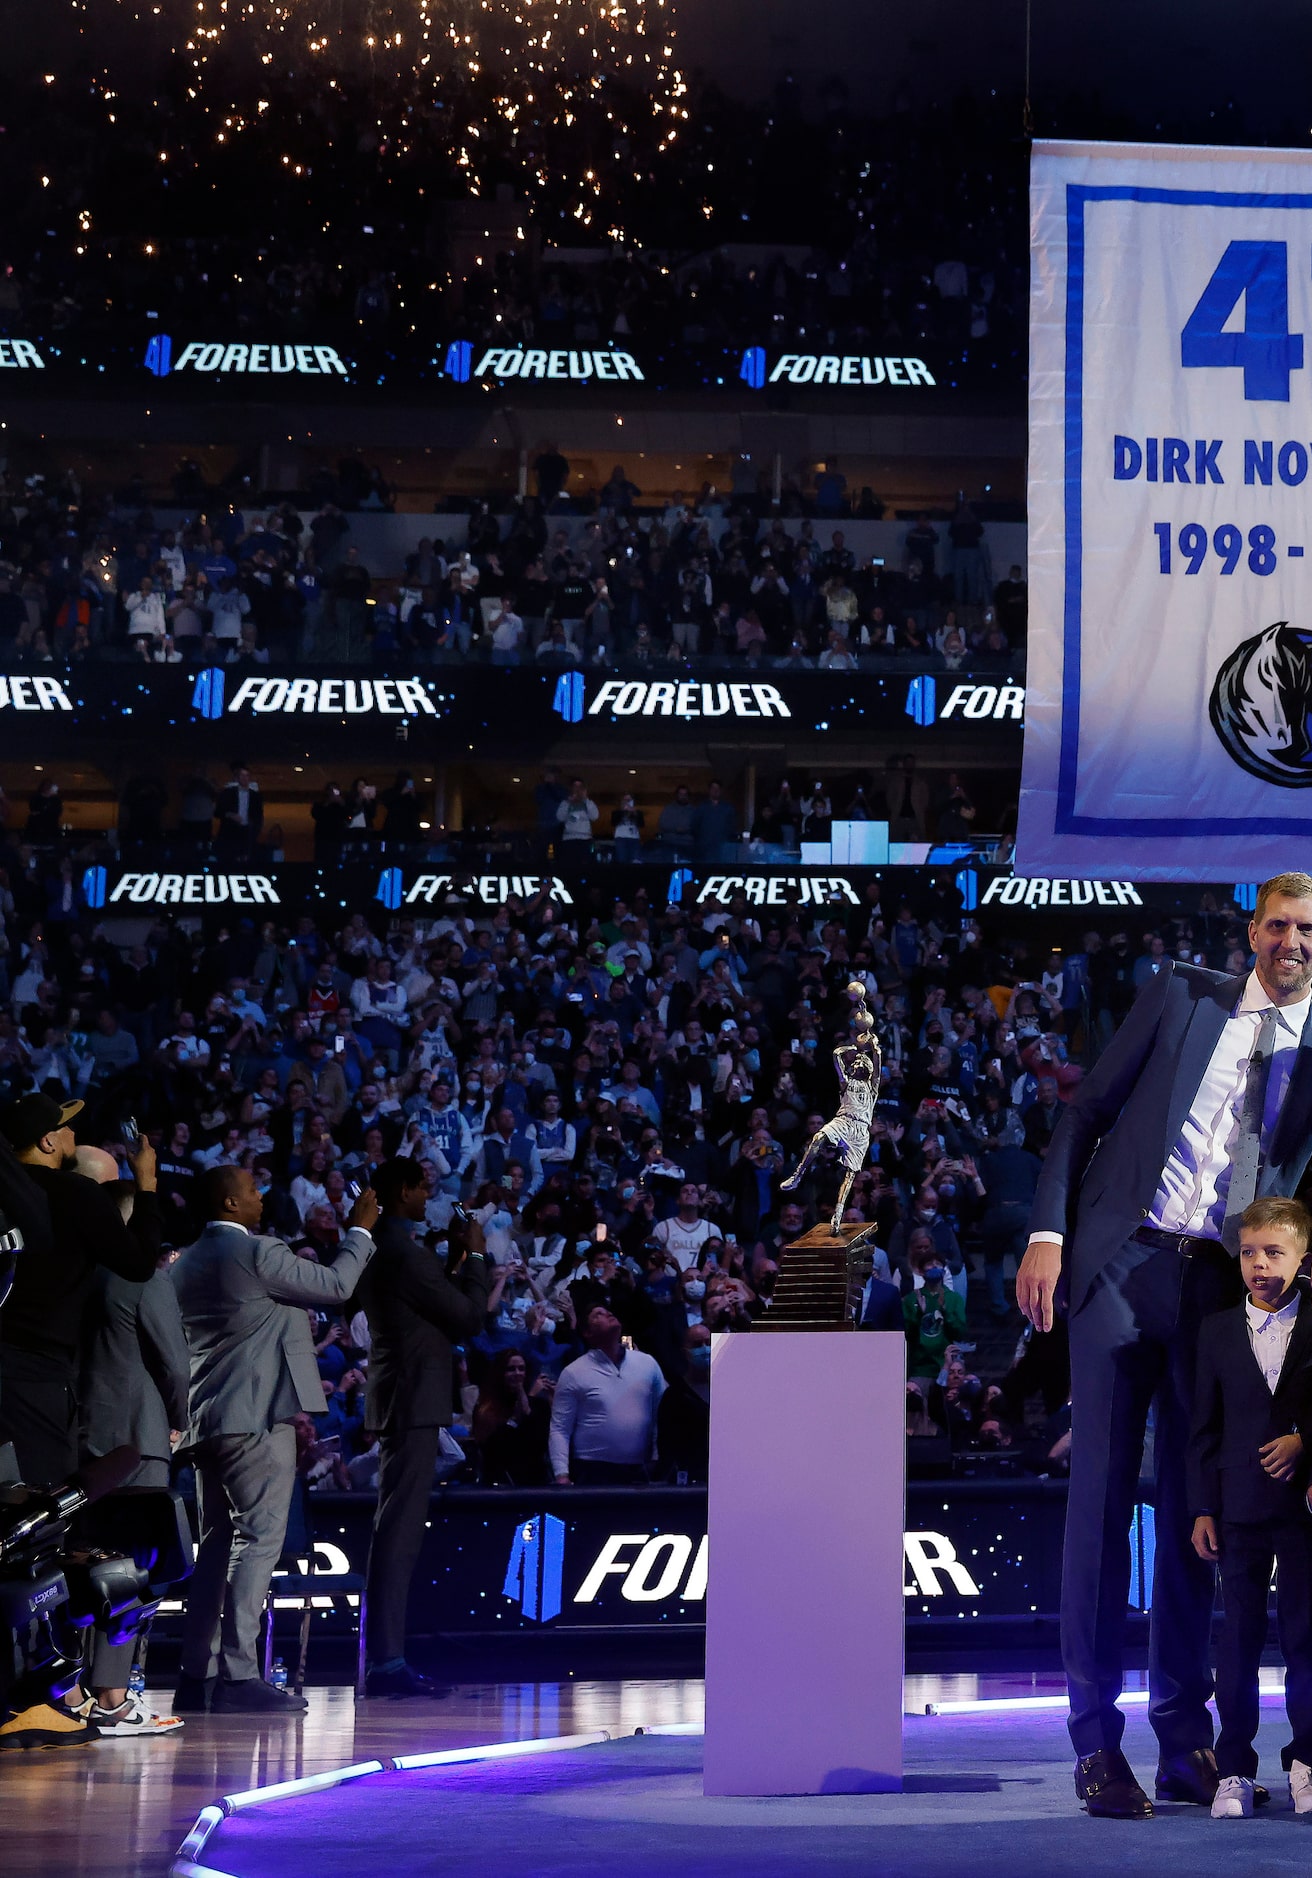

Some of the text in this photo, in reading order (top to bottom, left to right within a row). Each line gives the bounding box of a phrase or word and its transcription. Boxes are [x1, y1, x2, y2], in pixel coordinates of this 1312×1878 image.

[175, 344, 347, 373] FOREVER
[475, 350, 644, 379] FOREVER
[769, 356, 936, 385] FOREVER
[1113, 435, 1224, 484] DIRK
[229, 677, 436, 713] FOREVER
[589, 681, 791, 720] FOREVER
[110, 873, 281, 903] FOREVER
[406, 876, 573, 903] FOEVER
[672, 1240, 702, 1250] DALLA
